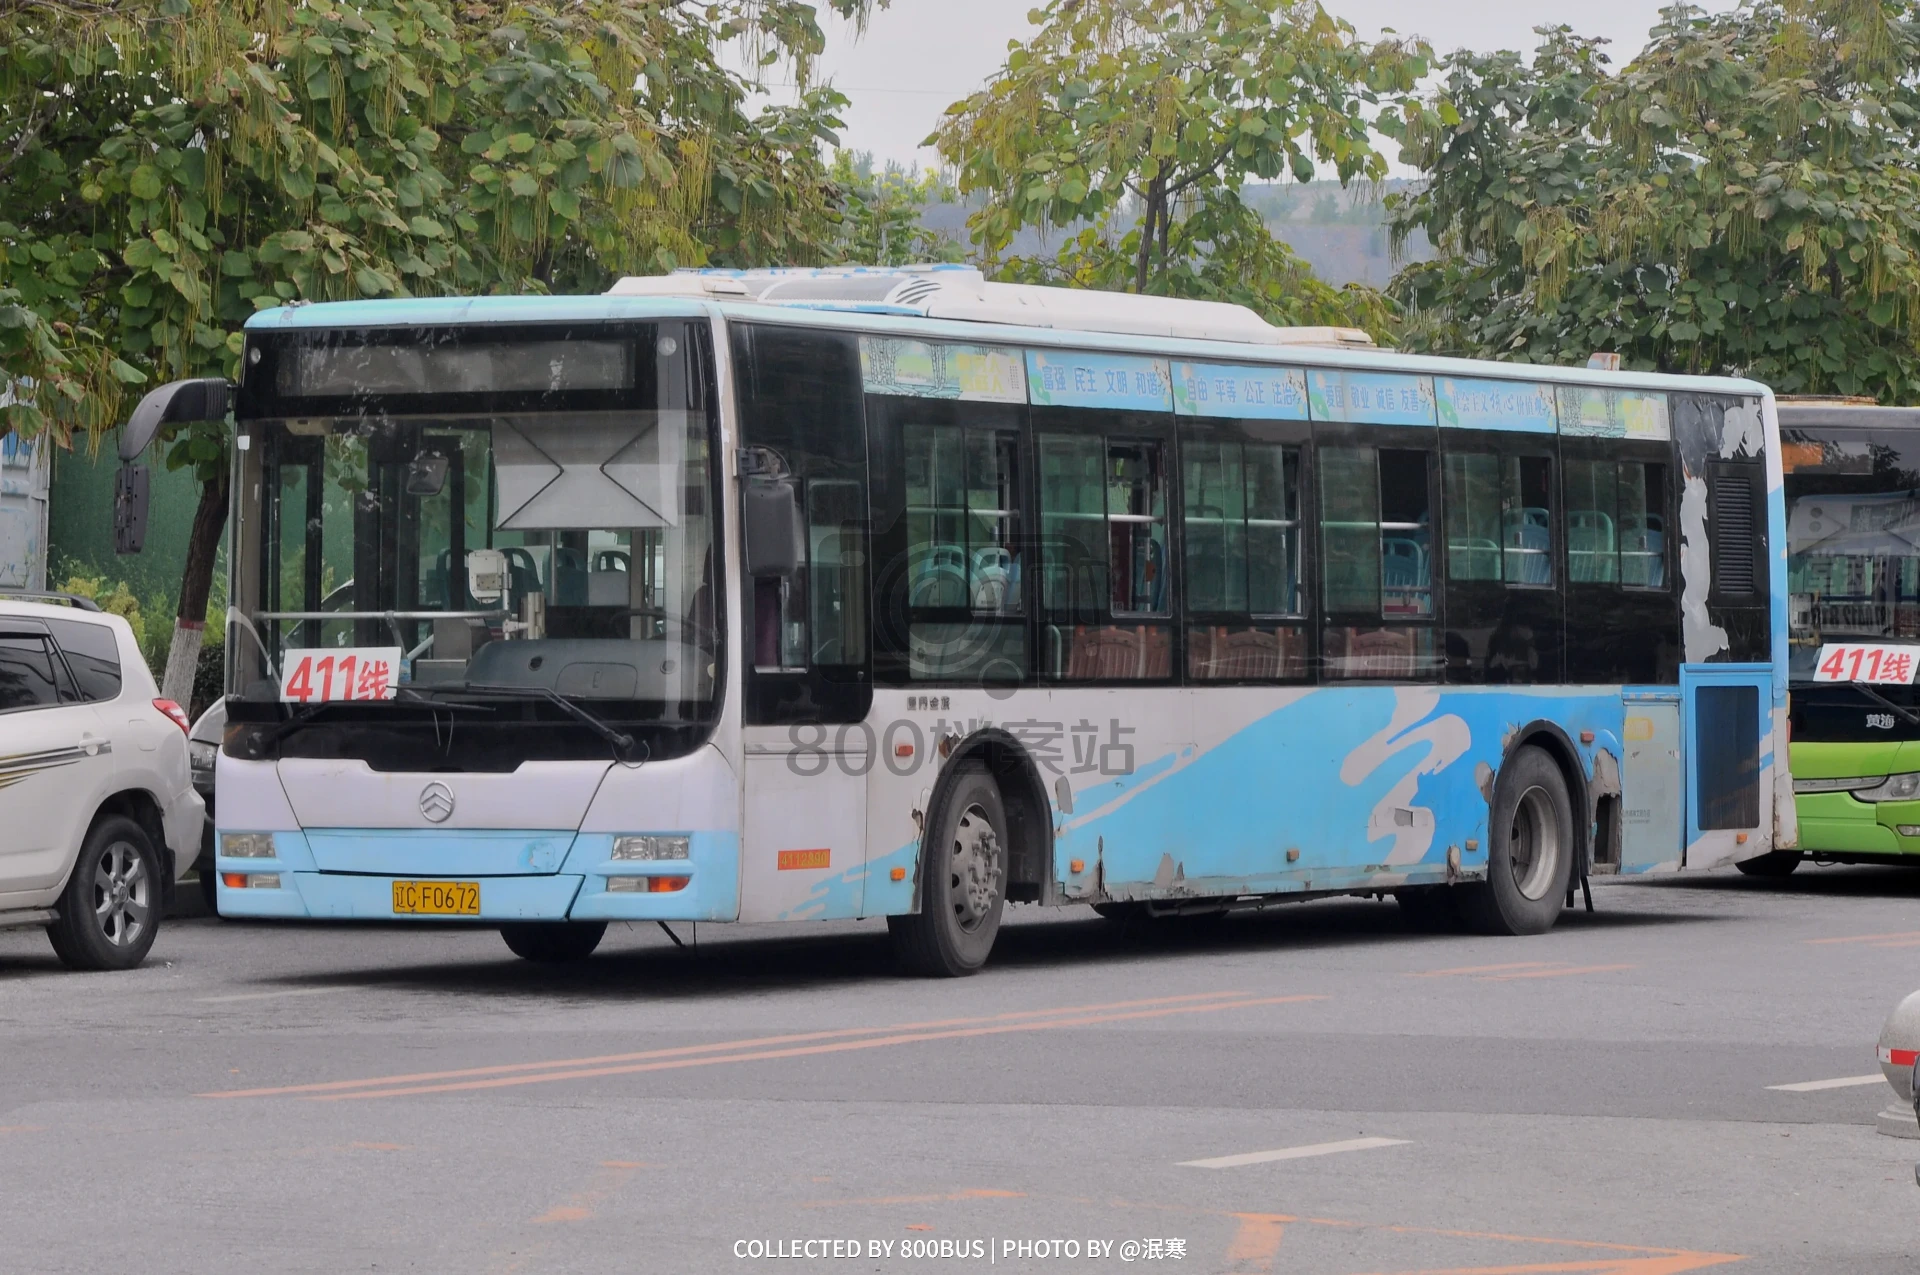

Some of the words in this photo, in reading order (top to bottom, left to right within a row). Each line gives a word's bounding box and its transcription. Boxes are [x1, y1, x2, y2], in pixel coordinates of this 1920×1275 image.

[1042, 366, 1067, 391] 富强
[1075, 367, 1097, 393] 民主
[1105, 369, 1128, 394] 文明
[1136, 371, 1159, 396] 和谐
[1187, 377, 1208, 401] 自由
[1215, 378, 1237, 403] 平等
[1244, 380, 1265, 404] 公正
[1272, 381, 1294, 405] 法治
[1325, 385, 1344, 408] 爱国
[1351, 385, 1370, 409] 敬业
[1376, 388, 1395, 411] 诚信
[1400, 388, 1419, 411] 友善
[286, 655, 389, 702] 411线
[1821, 648, 1911, 682] 411线
[1866, 713, 1895, 729] 黄海
